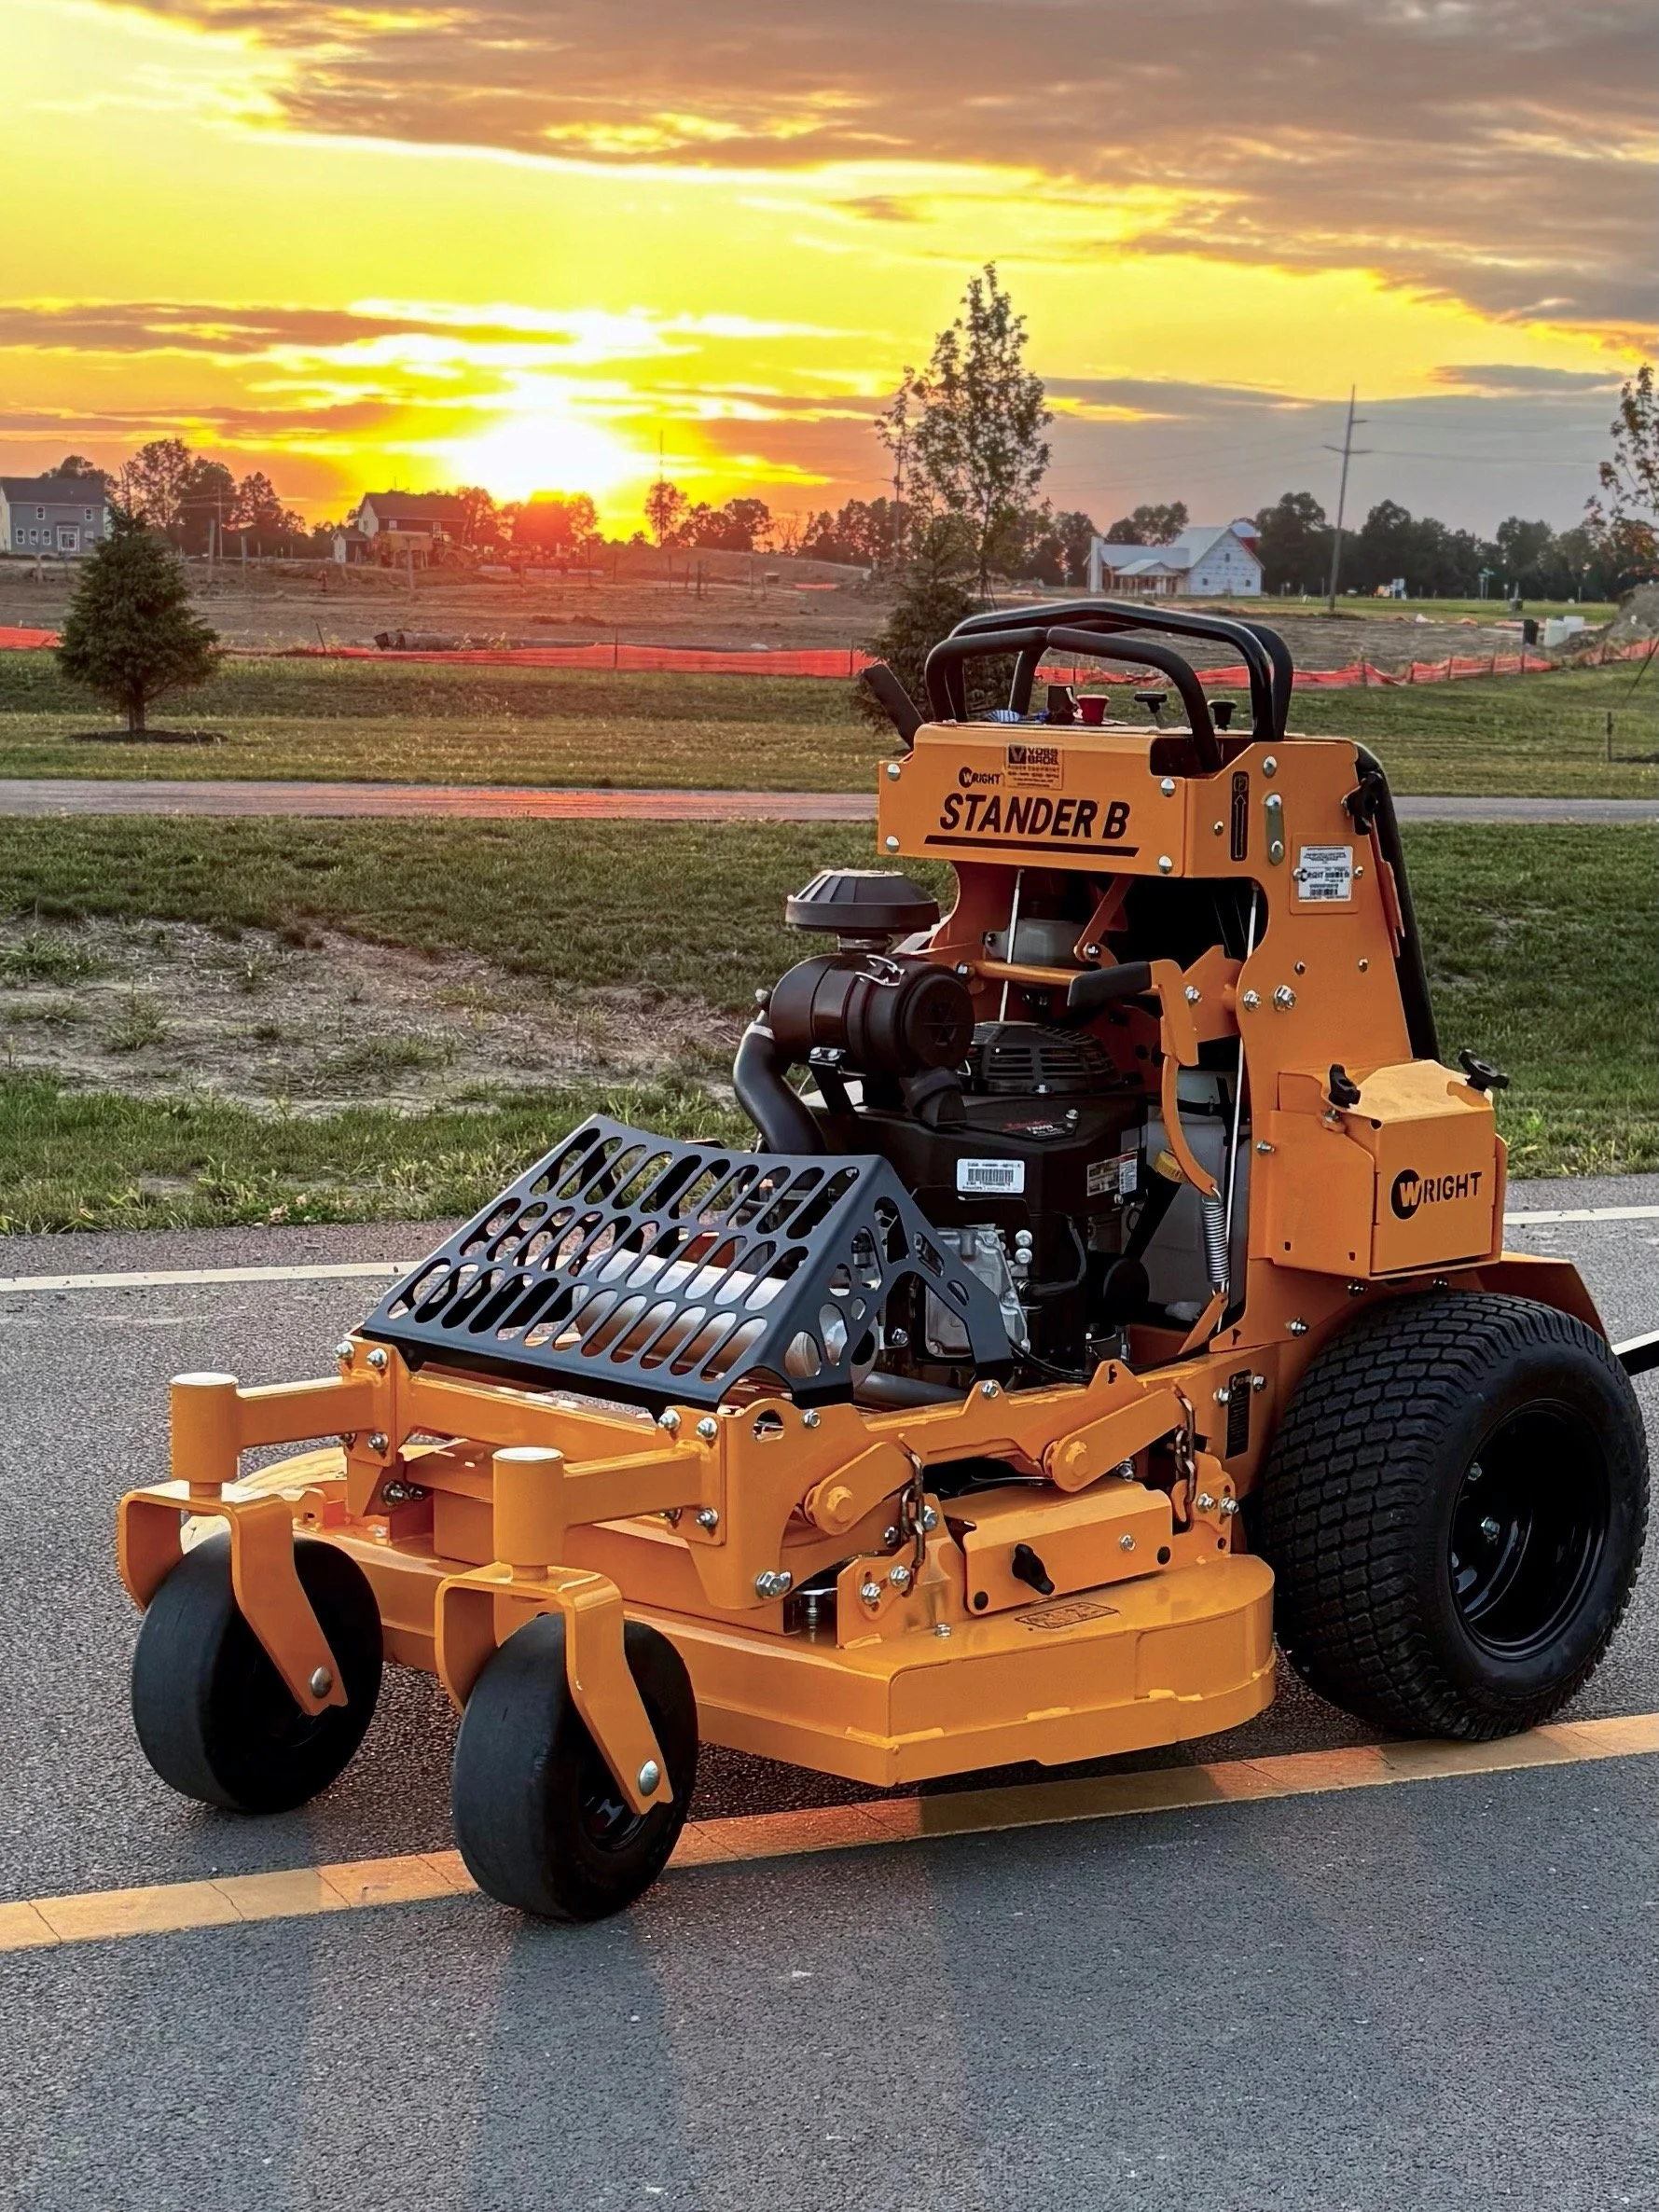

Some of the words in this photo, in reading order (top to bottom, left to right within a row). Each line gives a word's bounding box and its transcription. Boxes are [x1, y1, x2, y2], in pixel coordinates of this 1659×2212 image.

[959, 767, 1000, 788] WRIGHT
[940, 793, 1098, 838] STANDER
[1102, 801, 1130, 839] B
[1391, 1168, 1483, 1220] WRIGHT
